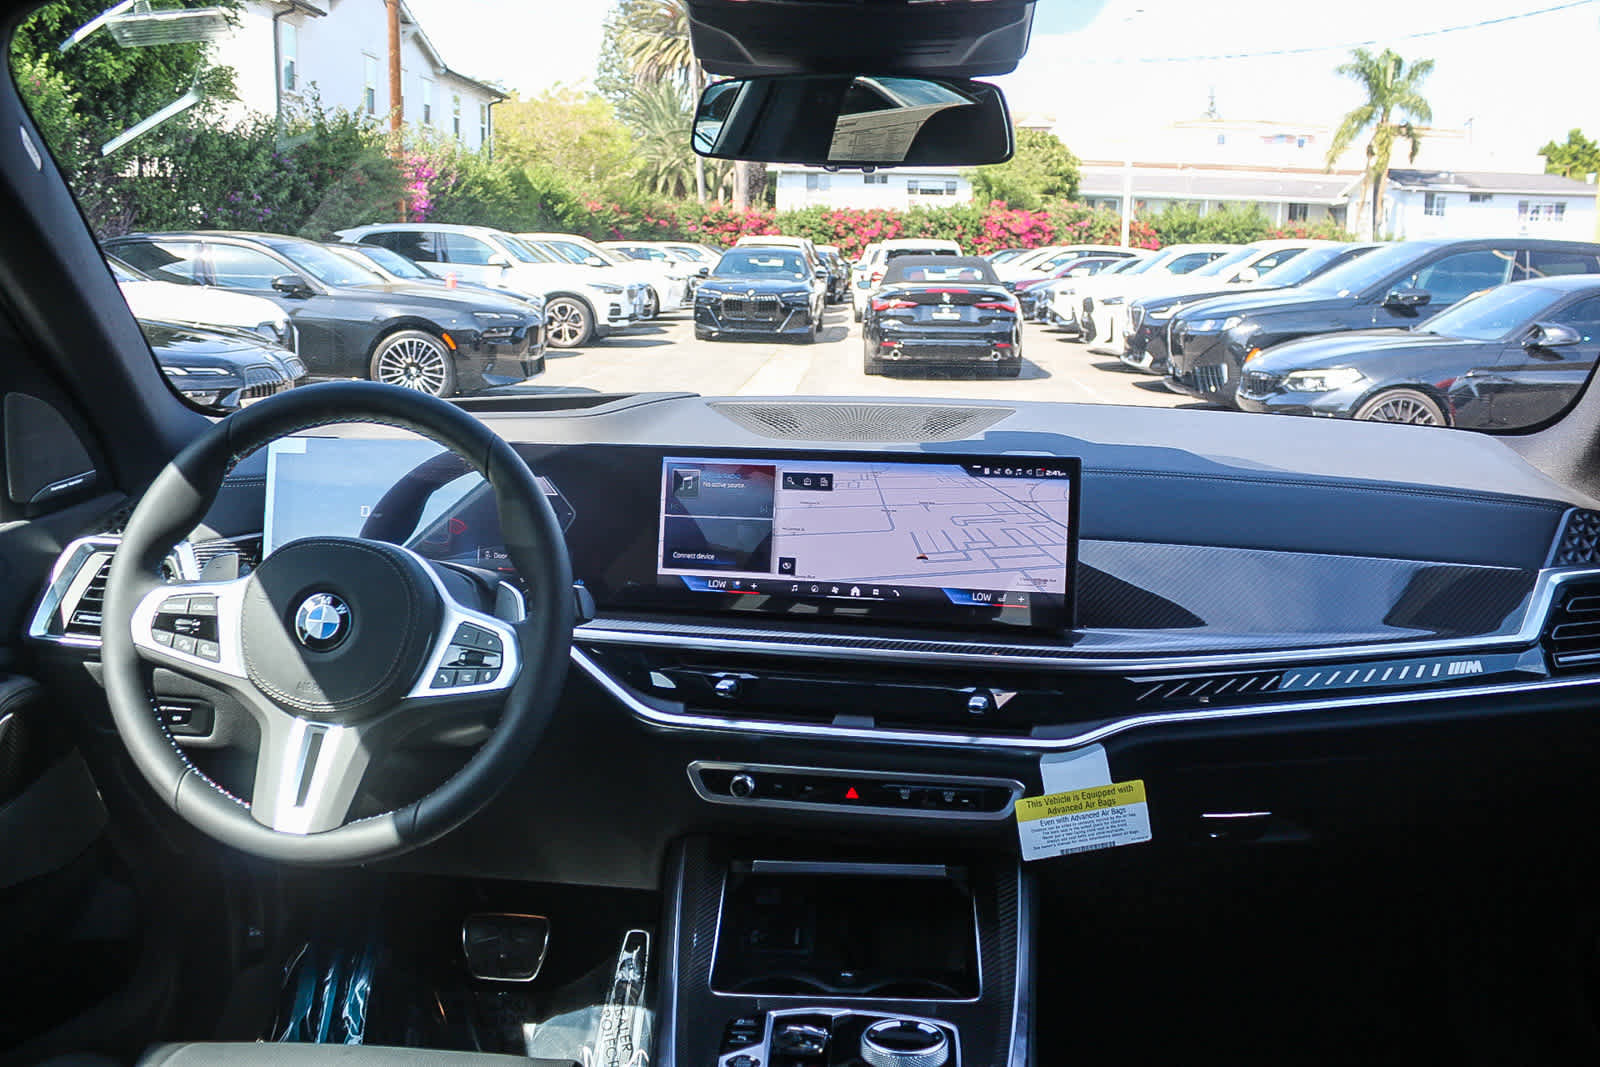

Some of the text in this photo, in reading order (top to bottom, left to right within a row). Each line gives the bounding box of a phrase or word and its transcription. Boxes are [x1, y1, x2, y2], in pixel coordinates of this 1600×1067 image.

[672, 551, 715, 561] Connect device
[708, 580, 726, 588] LOW
[972, 592, 992, 601] LOW
[1026, 784, 1134, 808] This Vehicle is Equipped with
[1047, 799, 1117, 815] Advanced Air Bags
[1040, 806, 1127, 827] Even with Advanced Air Bags
